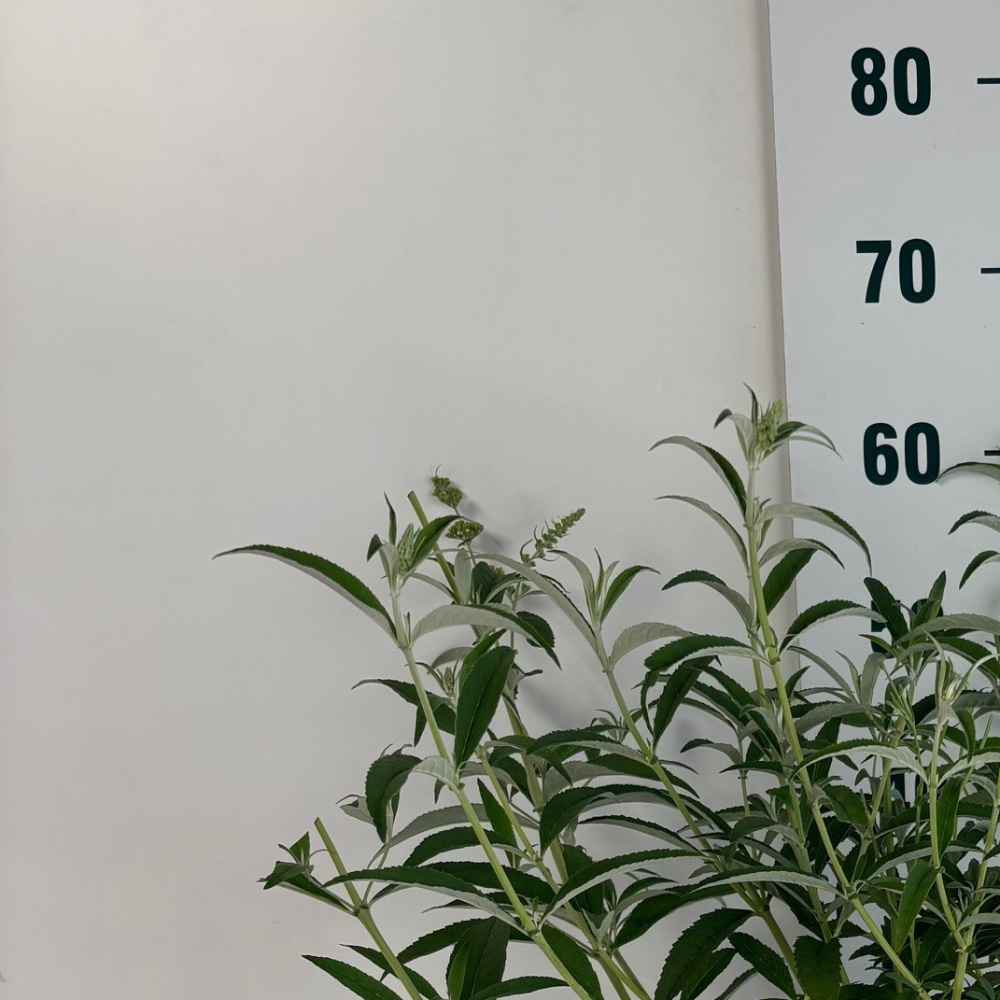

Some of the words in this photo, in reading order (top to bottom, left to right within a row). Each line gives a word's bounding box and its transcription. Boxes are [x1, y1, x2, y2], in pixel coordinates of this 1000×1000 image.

[851, 47, 931, 116] 80
[856, 238, 936, 304] 70
[863, 422, 940, 485] 60
